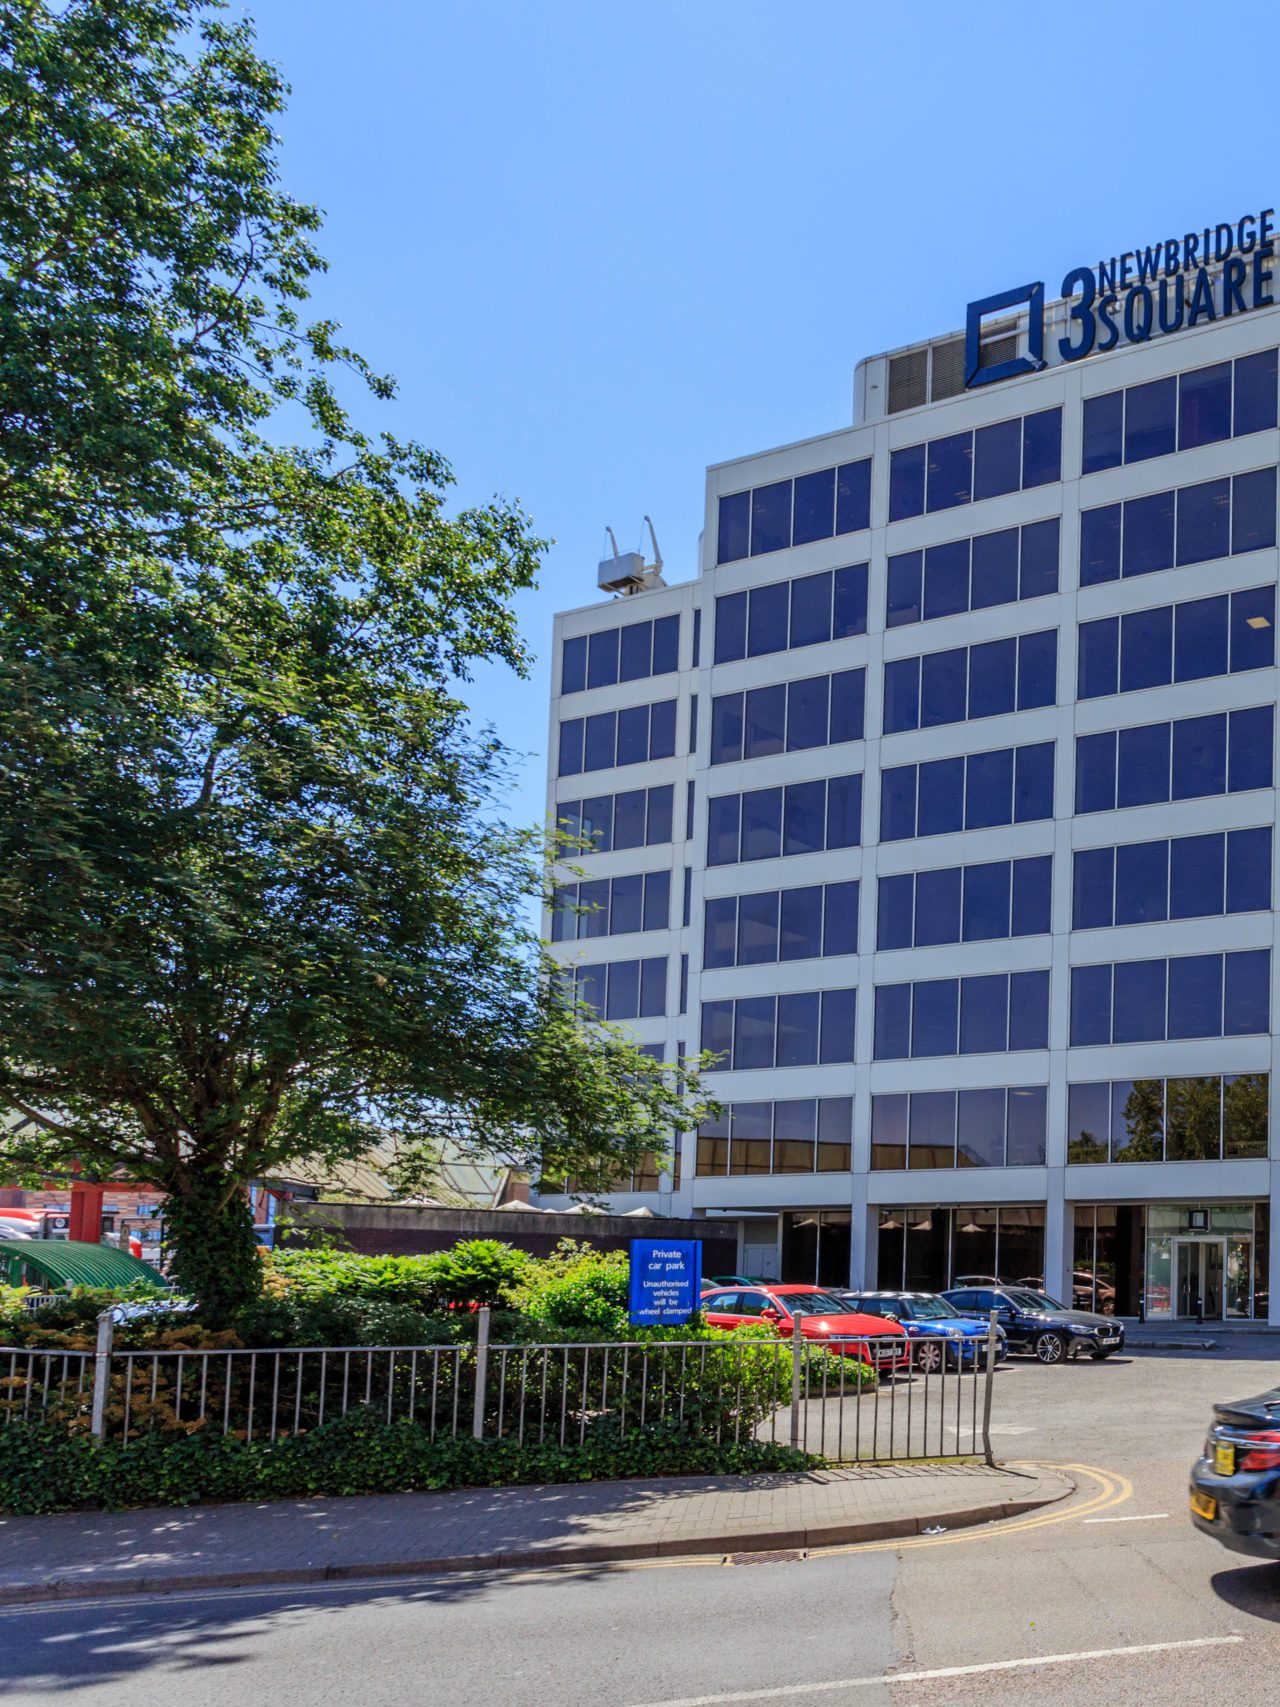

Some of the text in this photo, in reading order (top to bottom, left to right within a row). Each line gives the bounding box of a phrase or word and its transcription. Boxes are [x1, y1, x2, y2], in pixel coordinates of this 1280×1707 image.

[1098, 208, 1275, 297] NEWBRIDGE
[1058, 266, 1096, 362] 3
[1098, 247, 1274, 351] SQUARE
[652, 1250, 682, 1258] Private
[665, 1261, 685, 1271] park
[663, 1307, 692, 1315] clamped
